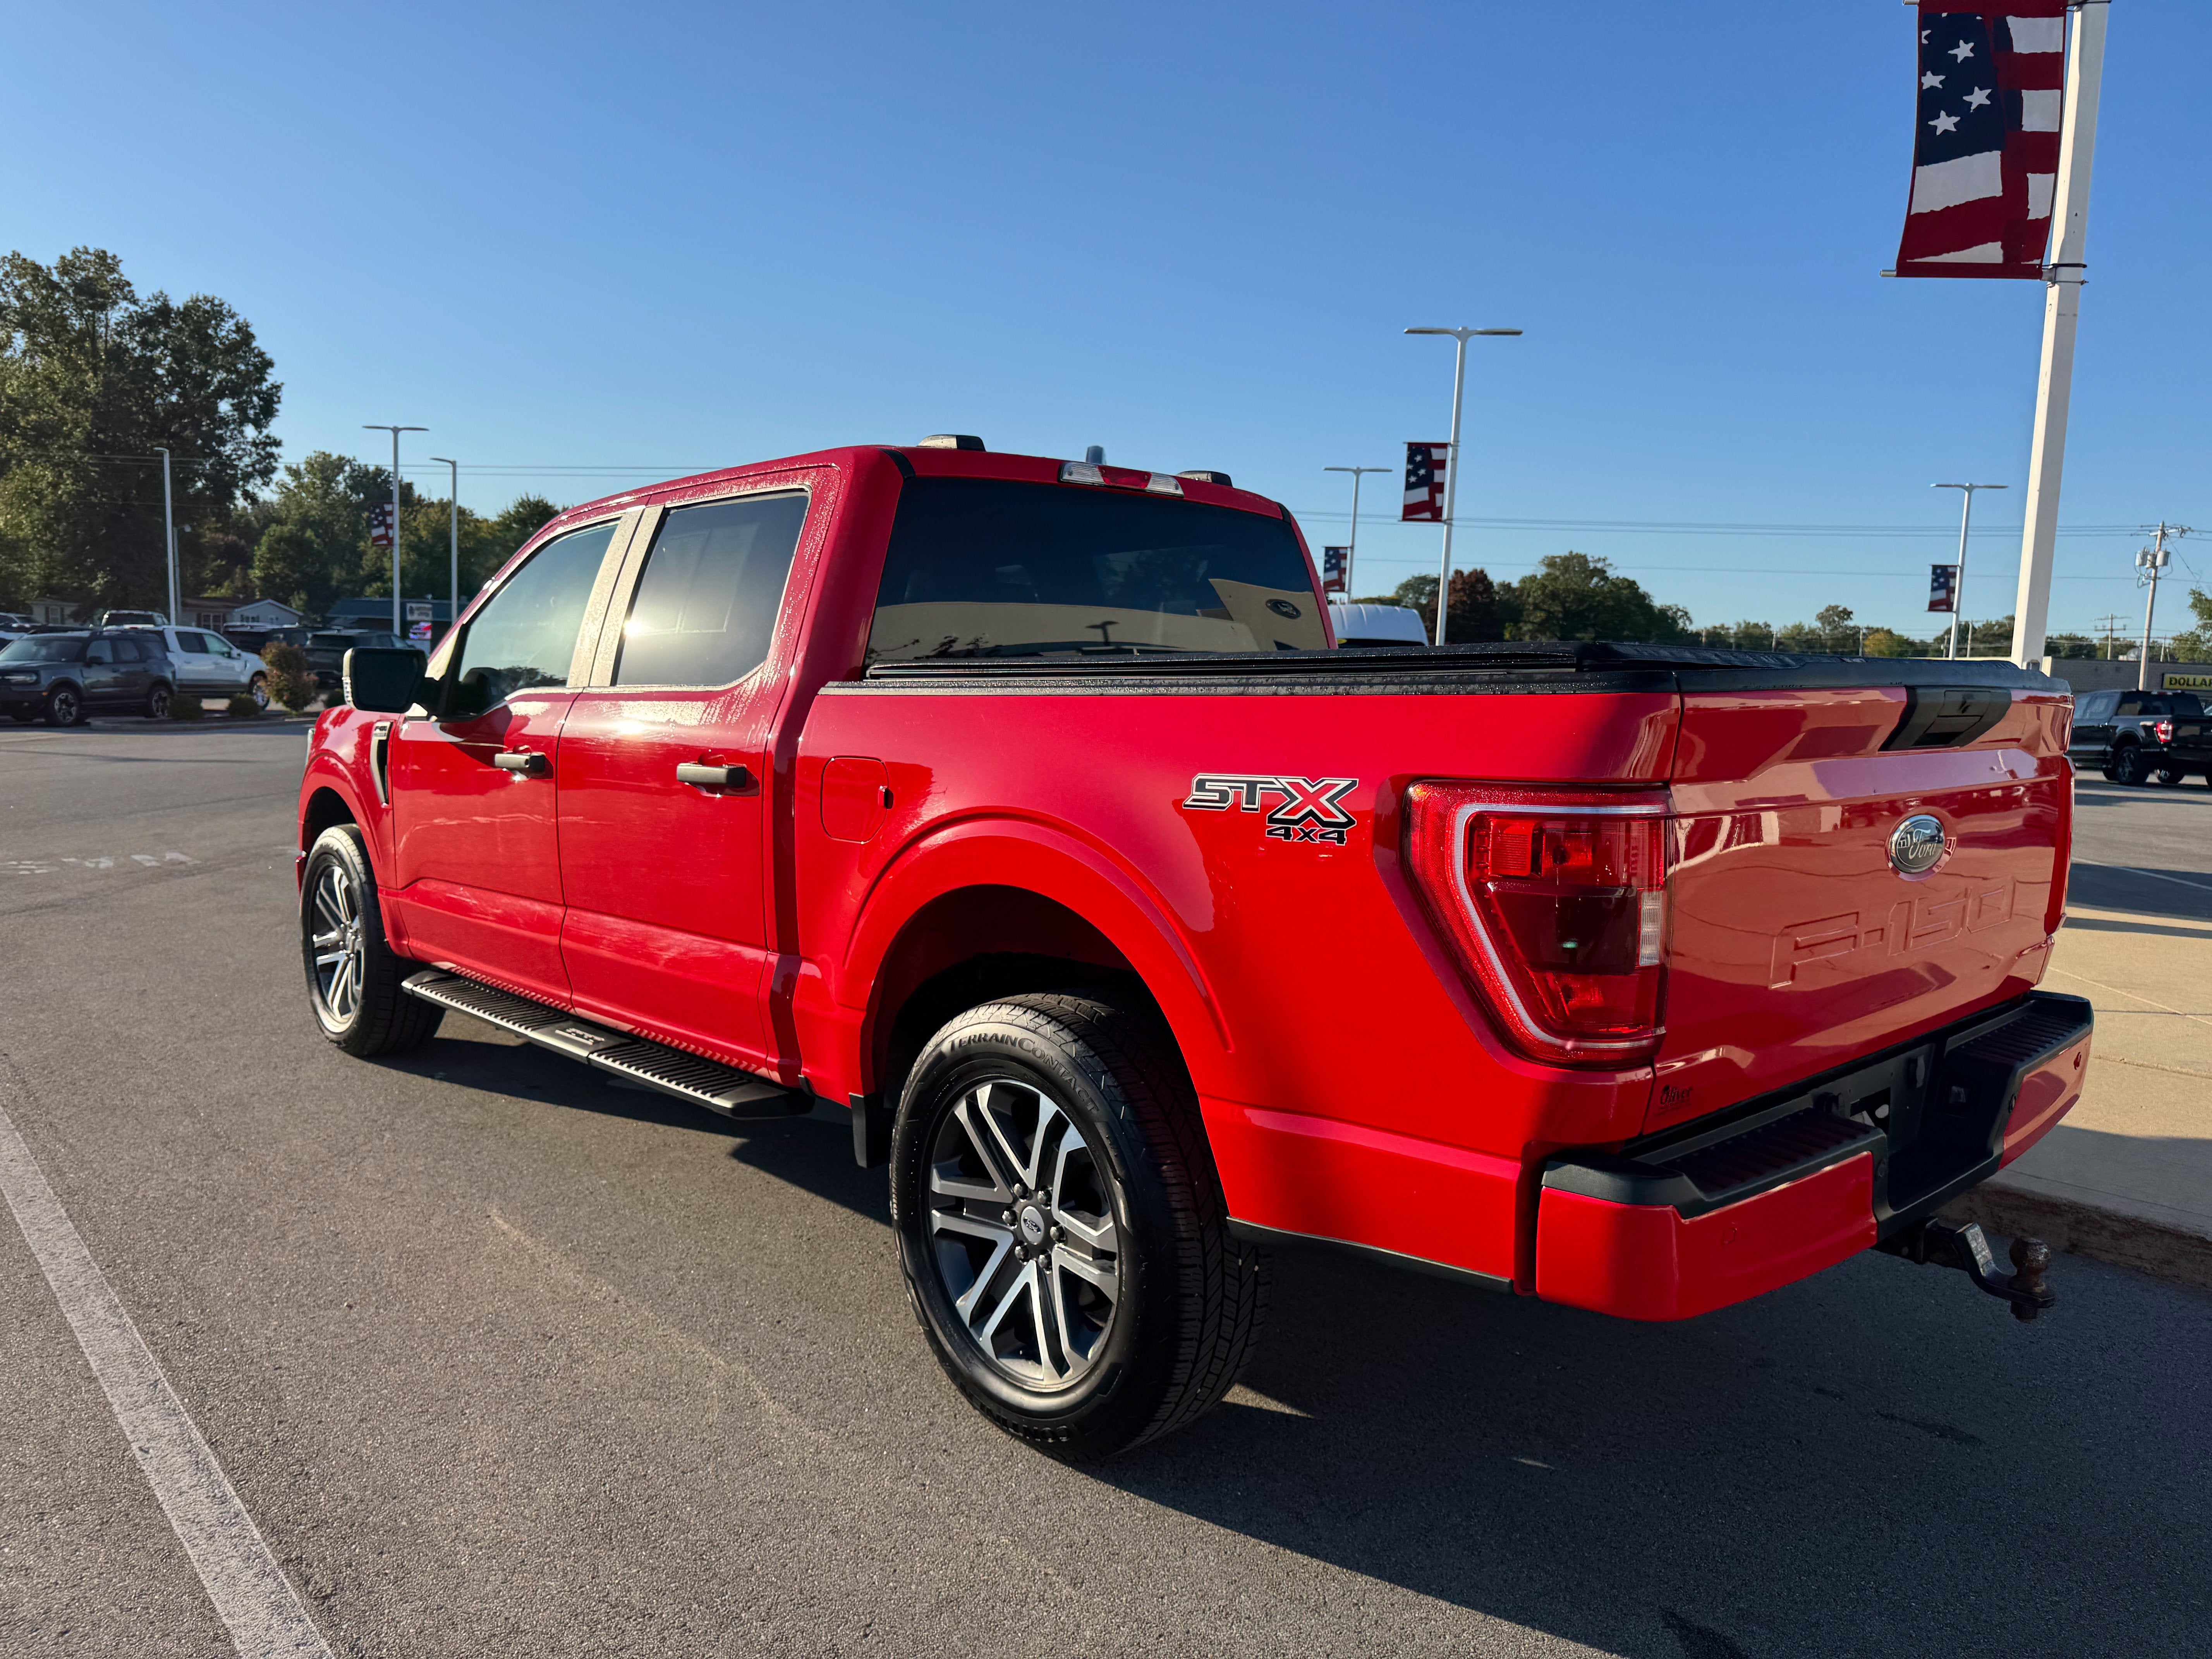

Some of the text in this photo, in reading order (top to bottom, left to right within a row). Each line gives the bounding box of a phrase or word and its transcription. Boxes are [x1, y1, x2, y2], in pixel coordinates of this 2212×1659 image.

[1182, 773, 1359, 830] STX
[1266, 826, 1347, 846] 4x4
[1908, 828, 1937, 860] Ford
[1769, 878, 2016, 990] F-150
